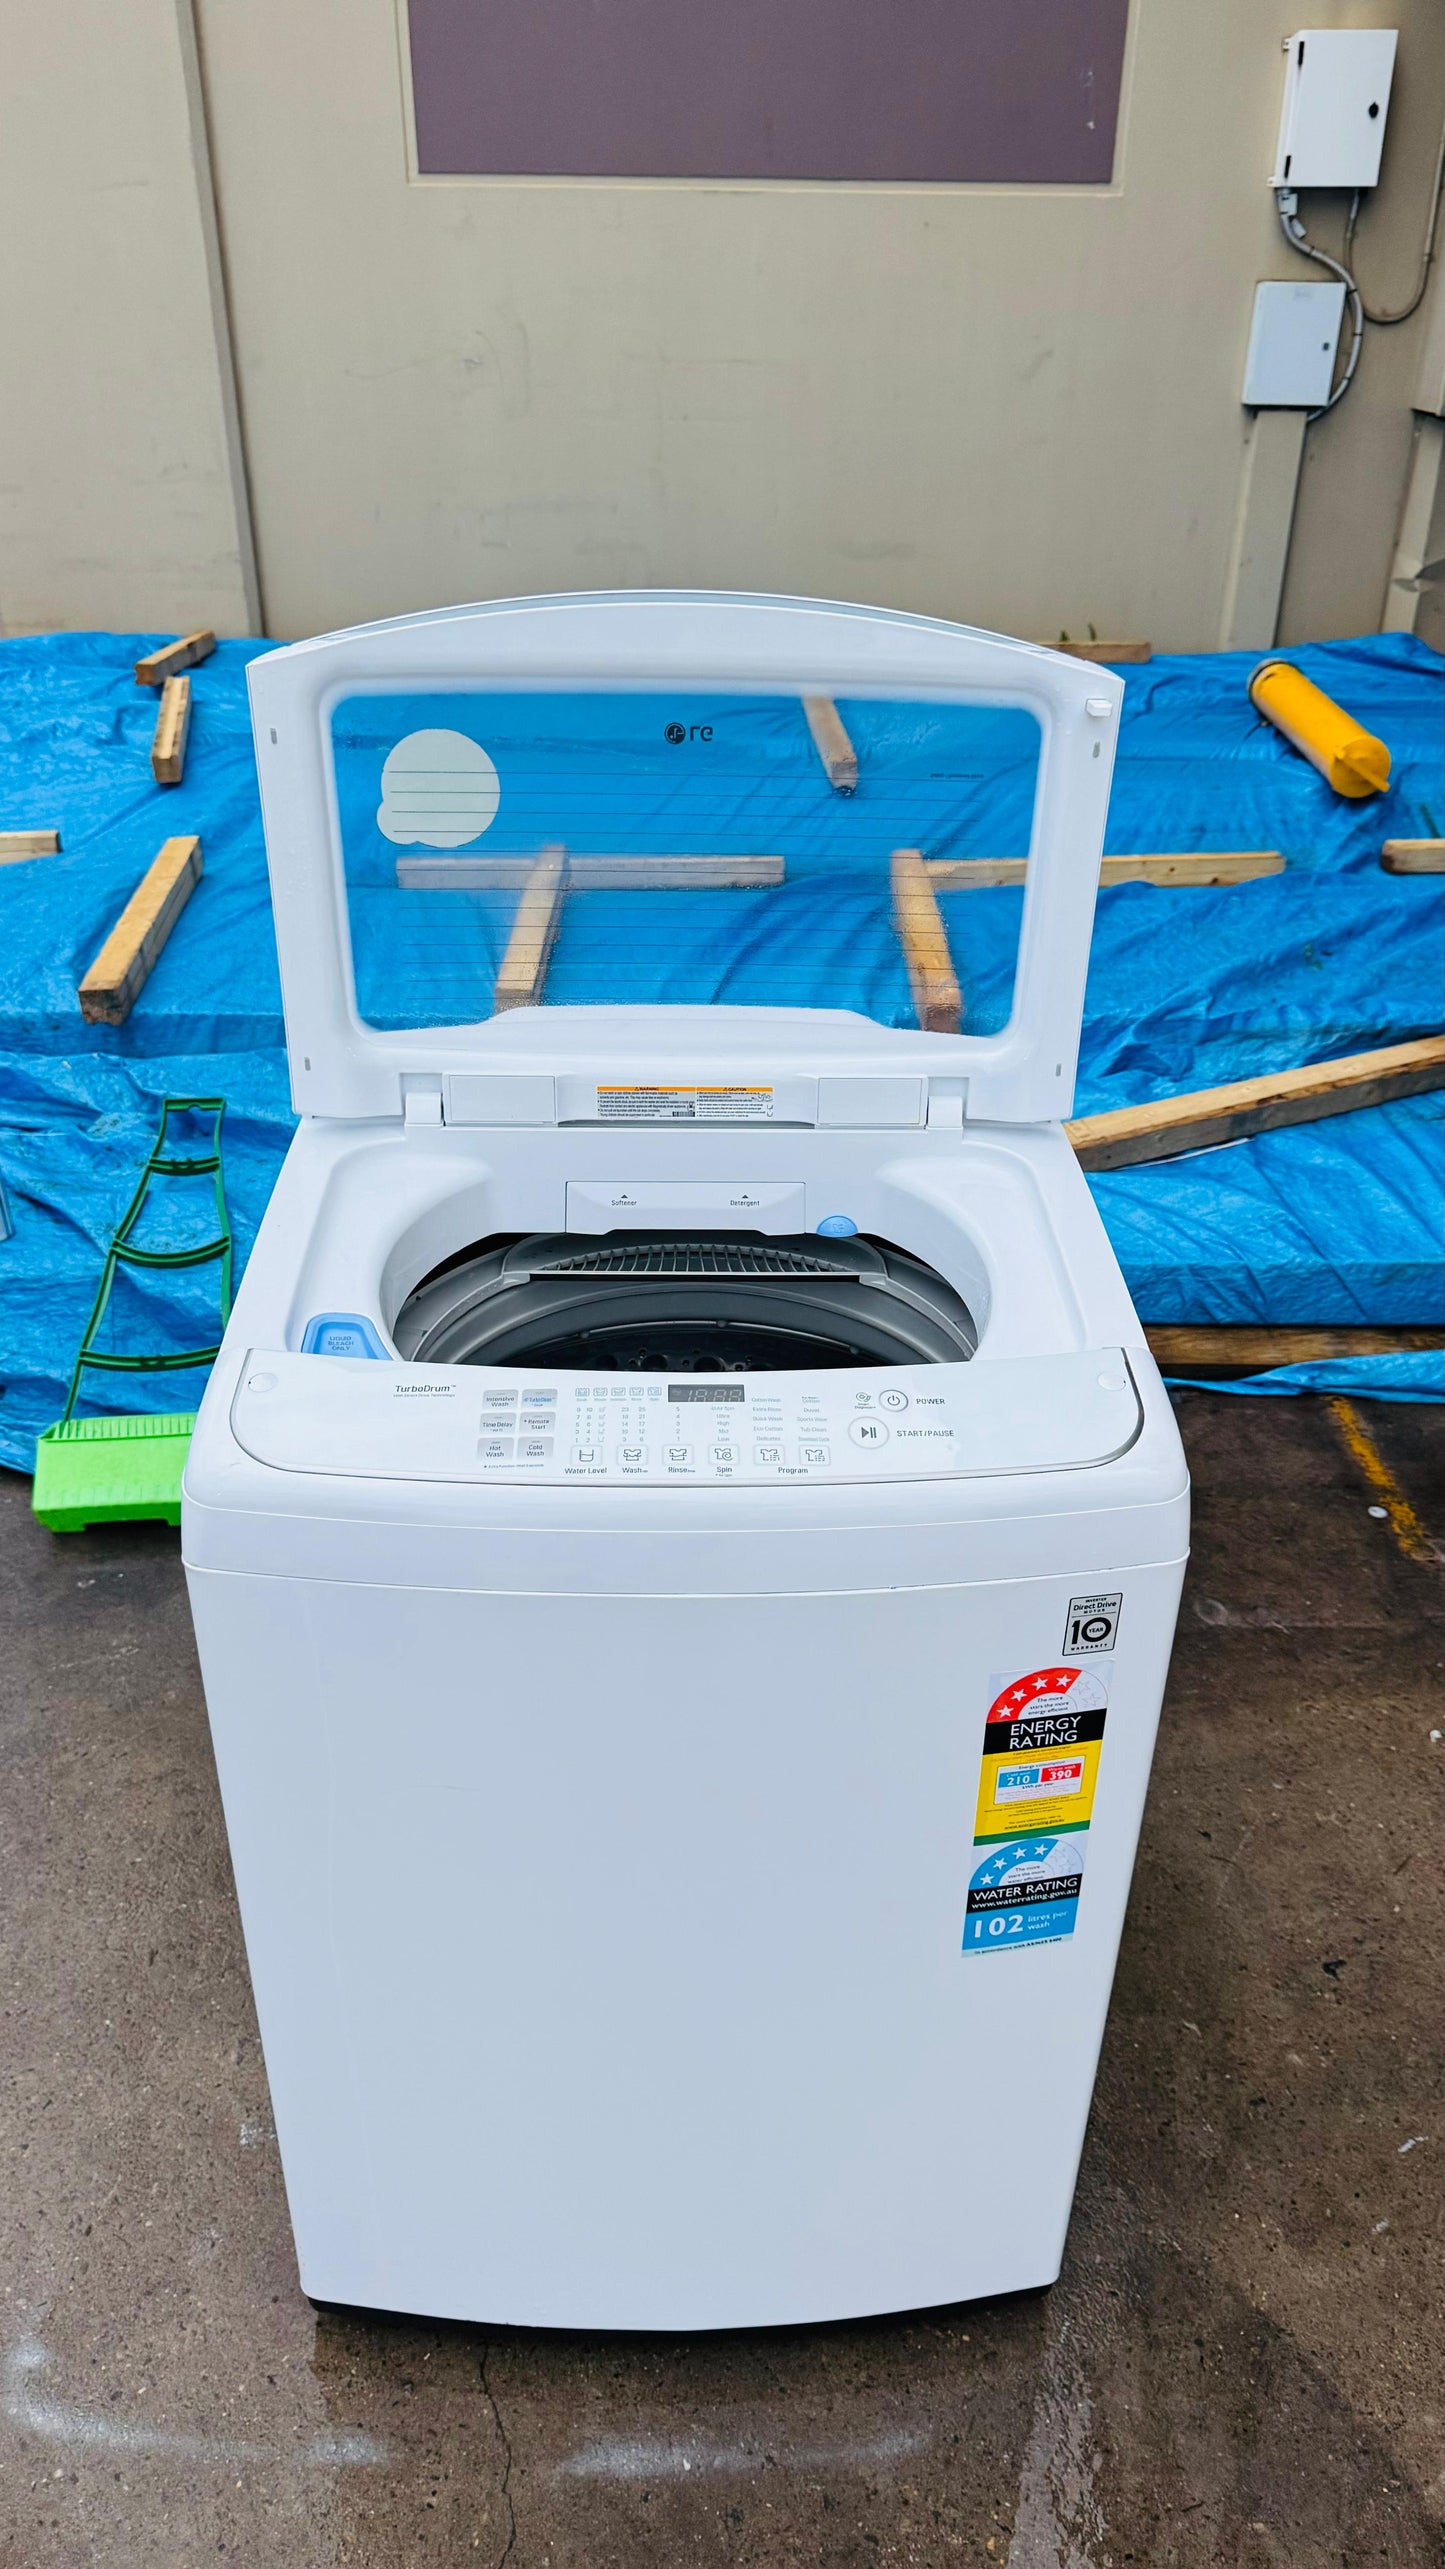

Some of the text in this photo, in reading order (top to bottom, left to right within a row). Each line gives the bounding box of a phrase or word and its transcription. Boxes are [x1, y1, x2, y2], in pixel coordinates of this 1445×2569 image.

[1072, 1617, 1112, 1644] 10
[1010, 1716, 1082, 1736] ENERGY
[1010, 1730, 1078, 1750] RATING
[1007, 1776, 1030, 1786] 210
[1050, 1770, 1072, 1780] 390
[972, 1889, 1077, 1909] www.waterrating.gov.au
[974, 1878, 1078, 1900] WATER RATING
[974, 1914, 1024, 1938] 102
[1028, 1911, 1068, 1922] litres per
[1028, 1922, 1050, 1930] wash
